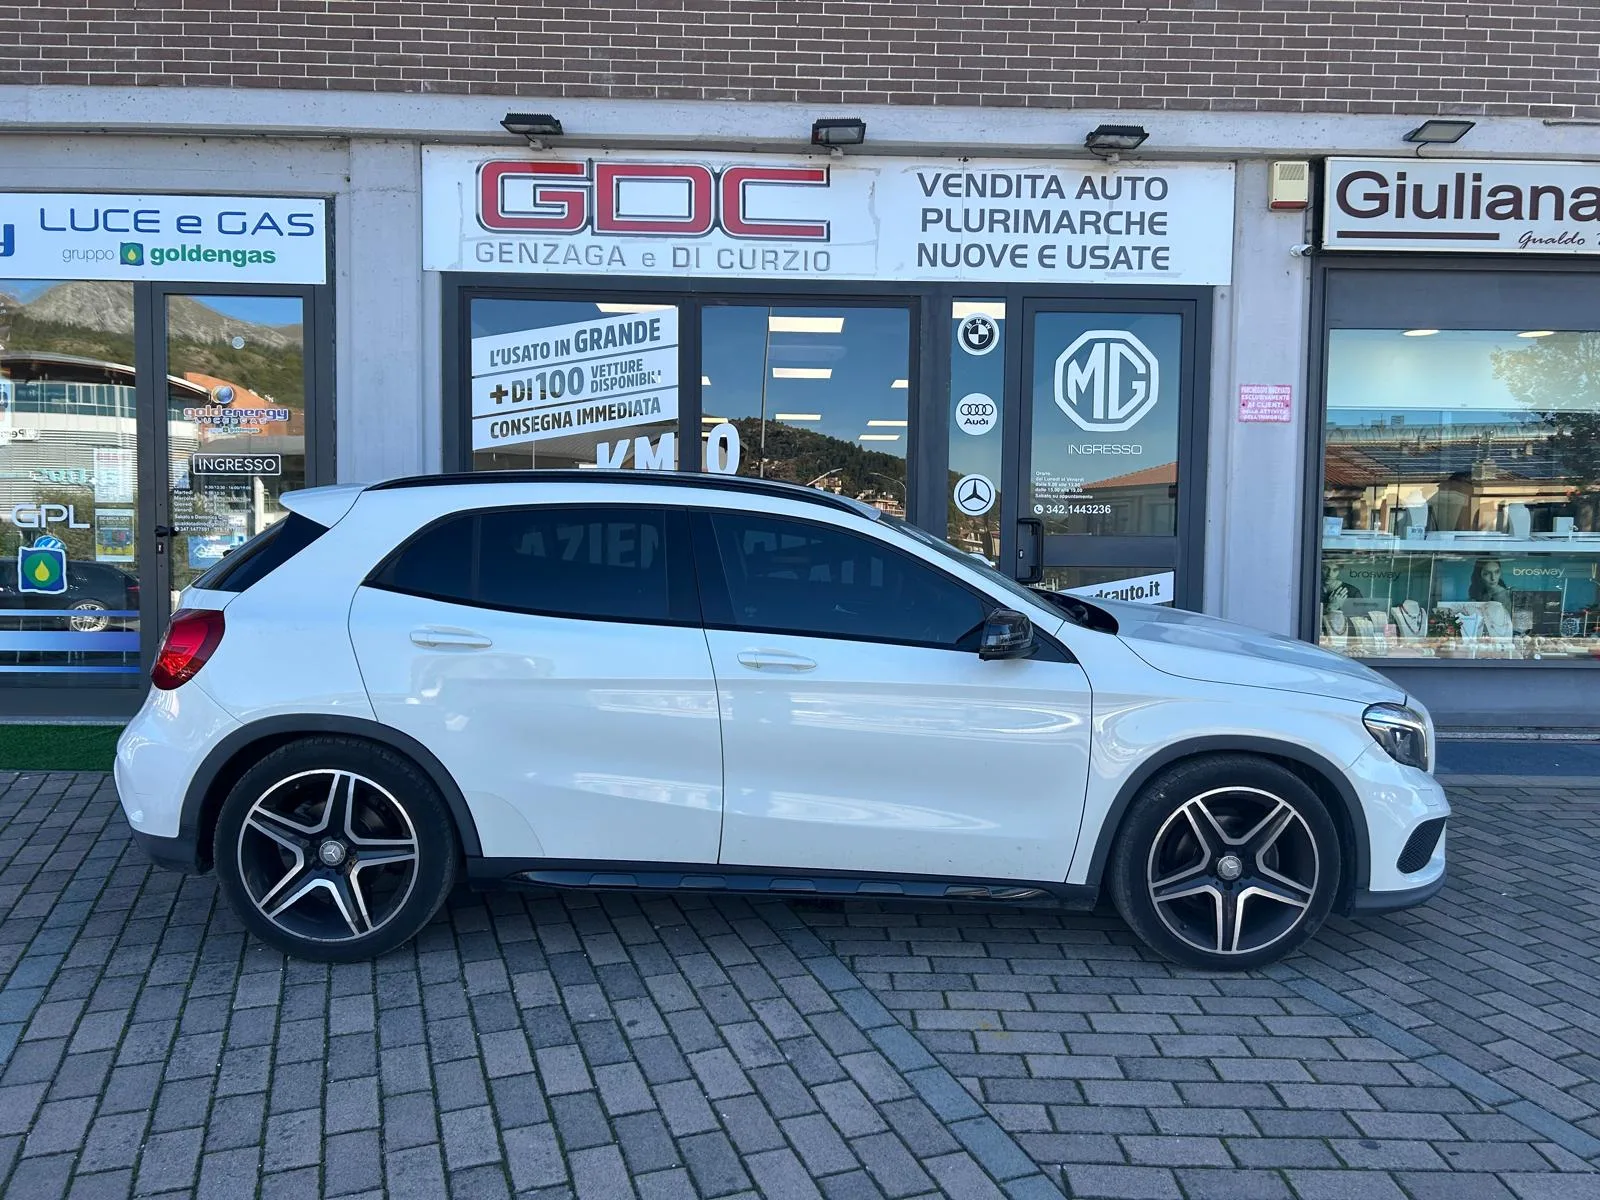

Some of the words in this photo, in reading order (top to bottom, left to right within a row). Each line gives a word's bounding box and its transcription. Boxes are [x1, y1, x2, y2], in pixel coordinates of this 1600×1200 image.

[476, 157, 831, 242] GDC
[917, 173, 1066, 200] VENDITA
[1075, 175, 1168, 201] AUTO
[1336, 170, 1600, 223] Giuliana
[40, 208, 160, 233] LUCE
[176, 215, 202, 234] e
[217, 212, 314, 237] GAS
[921, 208, 1168, 236] PLURIMARCHE
[62, 248, 115, 263] gruppo
[150, 244, 276, 267] goldengas
[475, 242, 627, 267] GENZAGA
[641, 252, 656, 267] e
[672, 247, 700, 268] DI
[717, 248, 831, 271] CURZIO
[917, 243, 1028, 268] NUOVE
[1038, 245, 1056, 268] E
[1066, 245, 1170, 270] USATE
[490, 342, 549, 367] L'USATO
[554, 338, 571, 357] IN
[574, 317, 661, 353] GRANDE
[590, 358, 643, 379] VETTURE
[1067, 342, 1147, 420] MG
[184, 404, 289, 421] goldenergy
[490, 409, 573, 439] CONSEGNA
[576, 396, 661, 426] IMMEDIATA
[964, 417, 989, 425] Audi
[1068, 443, 1143, 455] INGRESSO
[198, 458, 276, 472] INGRESSO
[11, 503, 91, 529] GPL
[1046, 504, 1112, 515] 342.1443236
[1512, 567, 1566, 579] brosway
